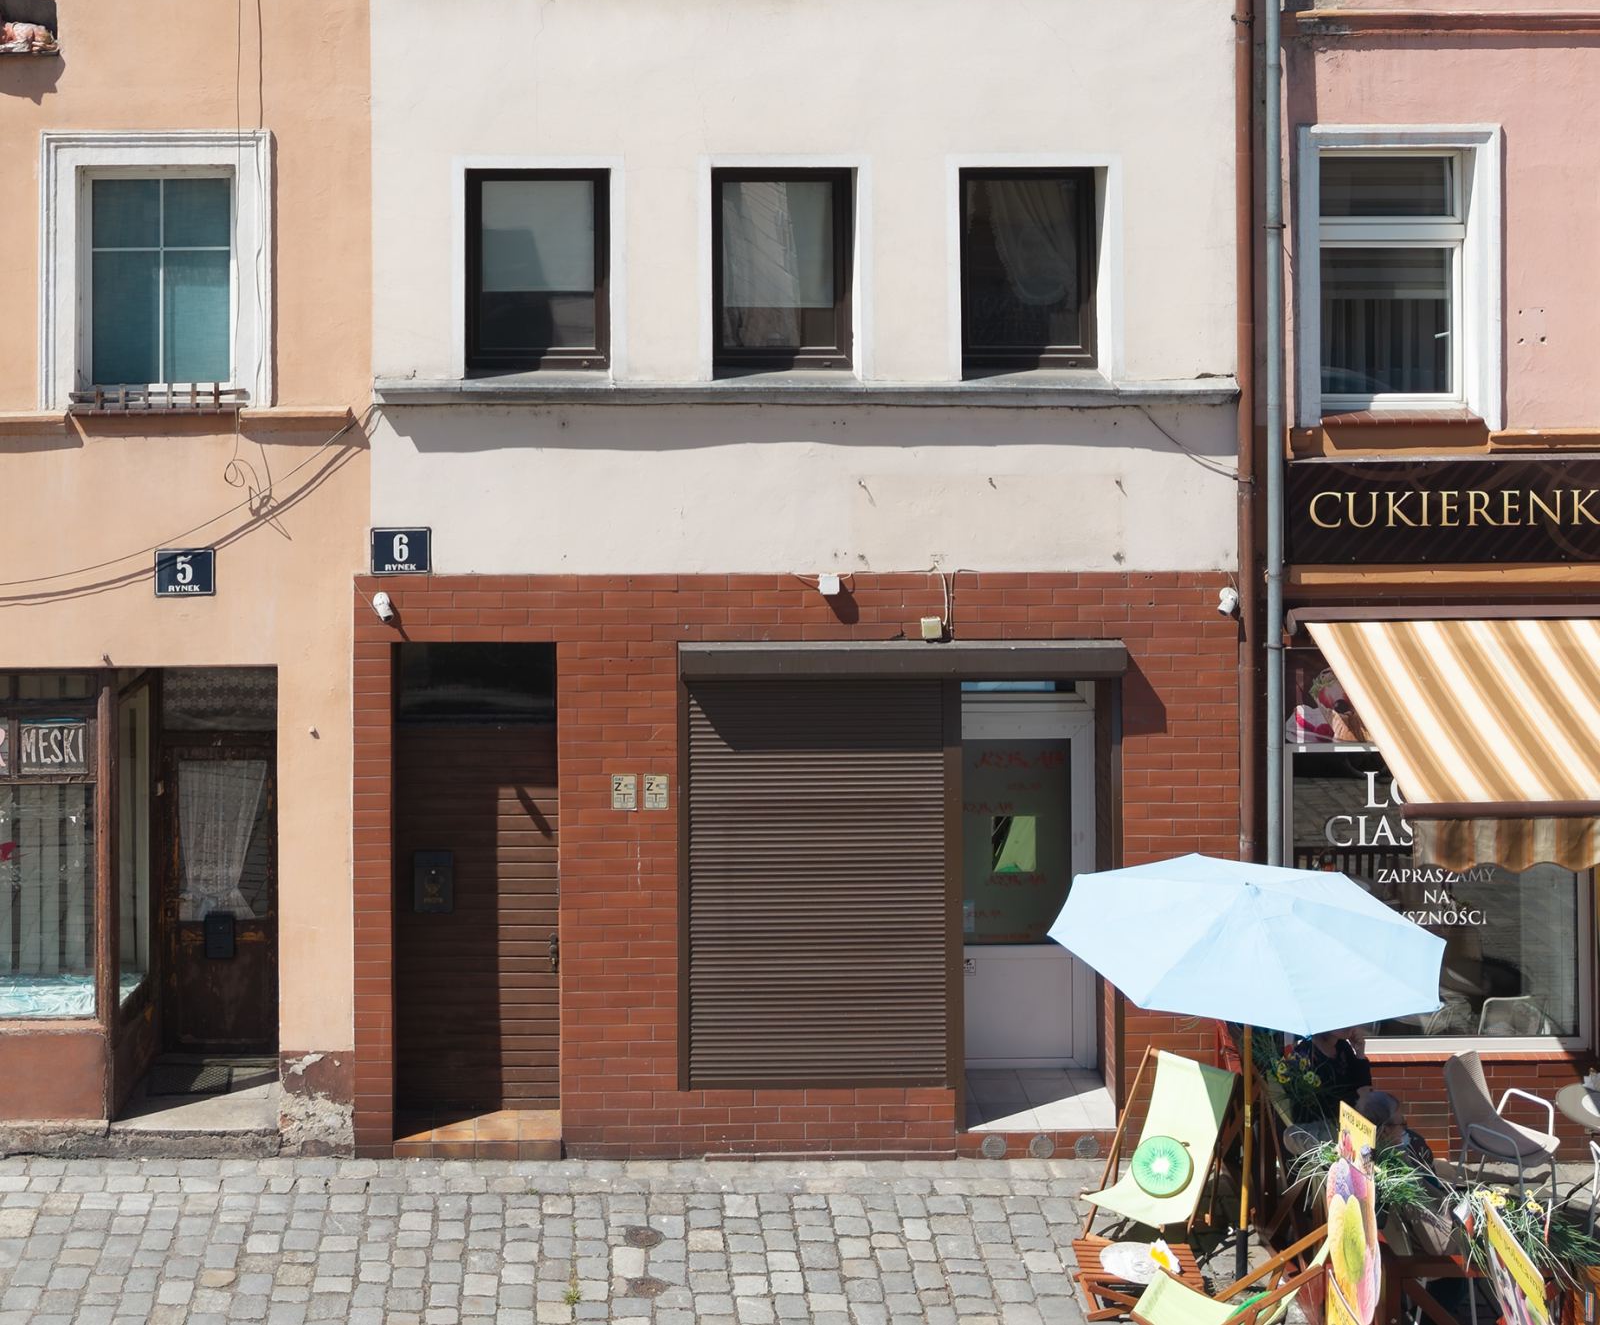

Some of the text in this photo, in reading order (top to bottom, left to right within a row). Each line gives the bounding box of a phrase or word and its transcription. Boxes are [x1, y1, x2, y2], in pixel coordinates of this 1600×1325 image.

[1309, 489, 1600, 528] CUKIERENK
[393, 533, 409, 562] 6
[176, 555, 193, 584] 5
[385, 563, 416, 571] RYNEK
[168, 584, 200, 592] RYNEK
[1377, 869, 1495, 884] ZAPRASZAMY
[1424, 889, 1451, 905] NA
